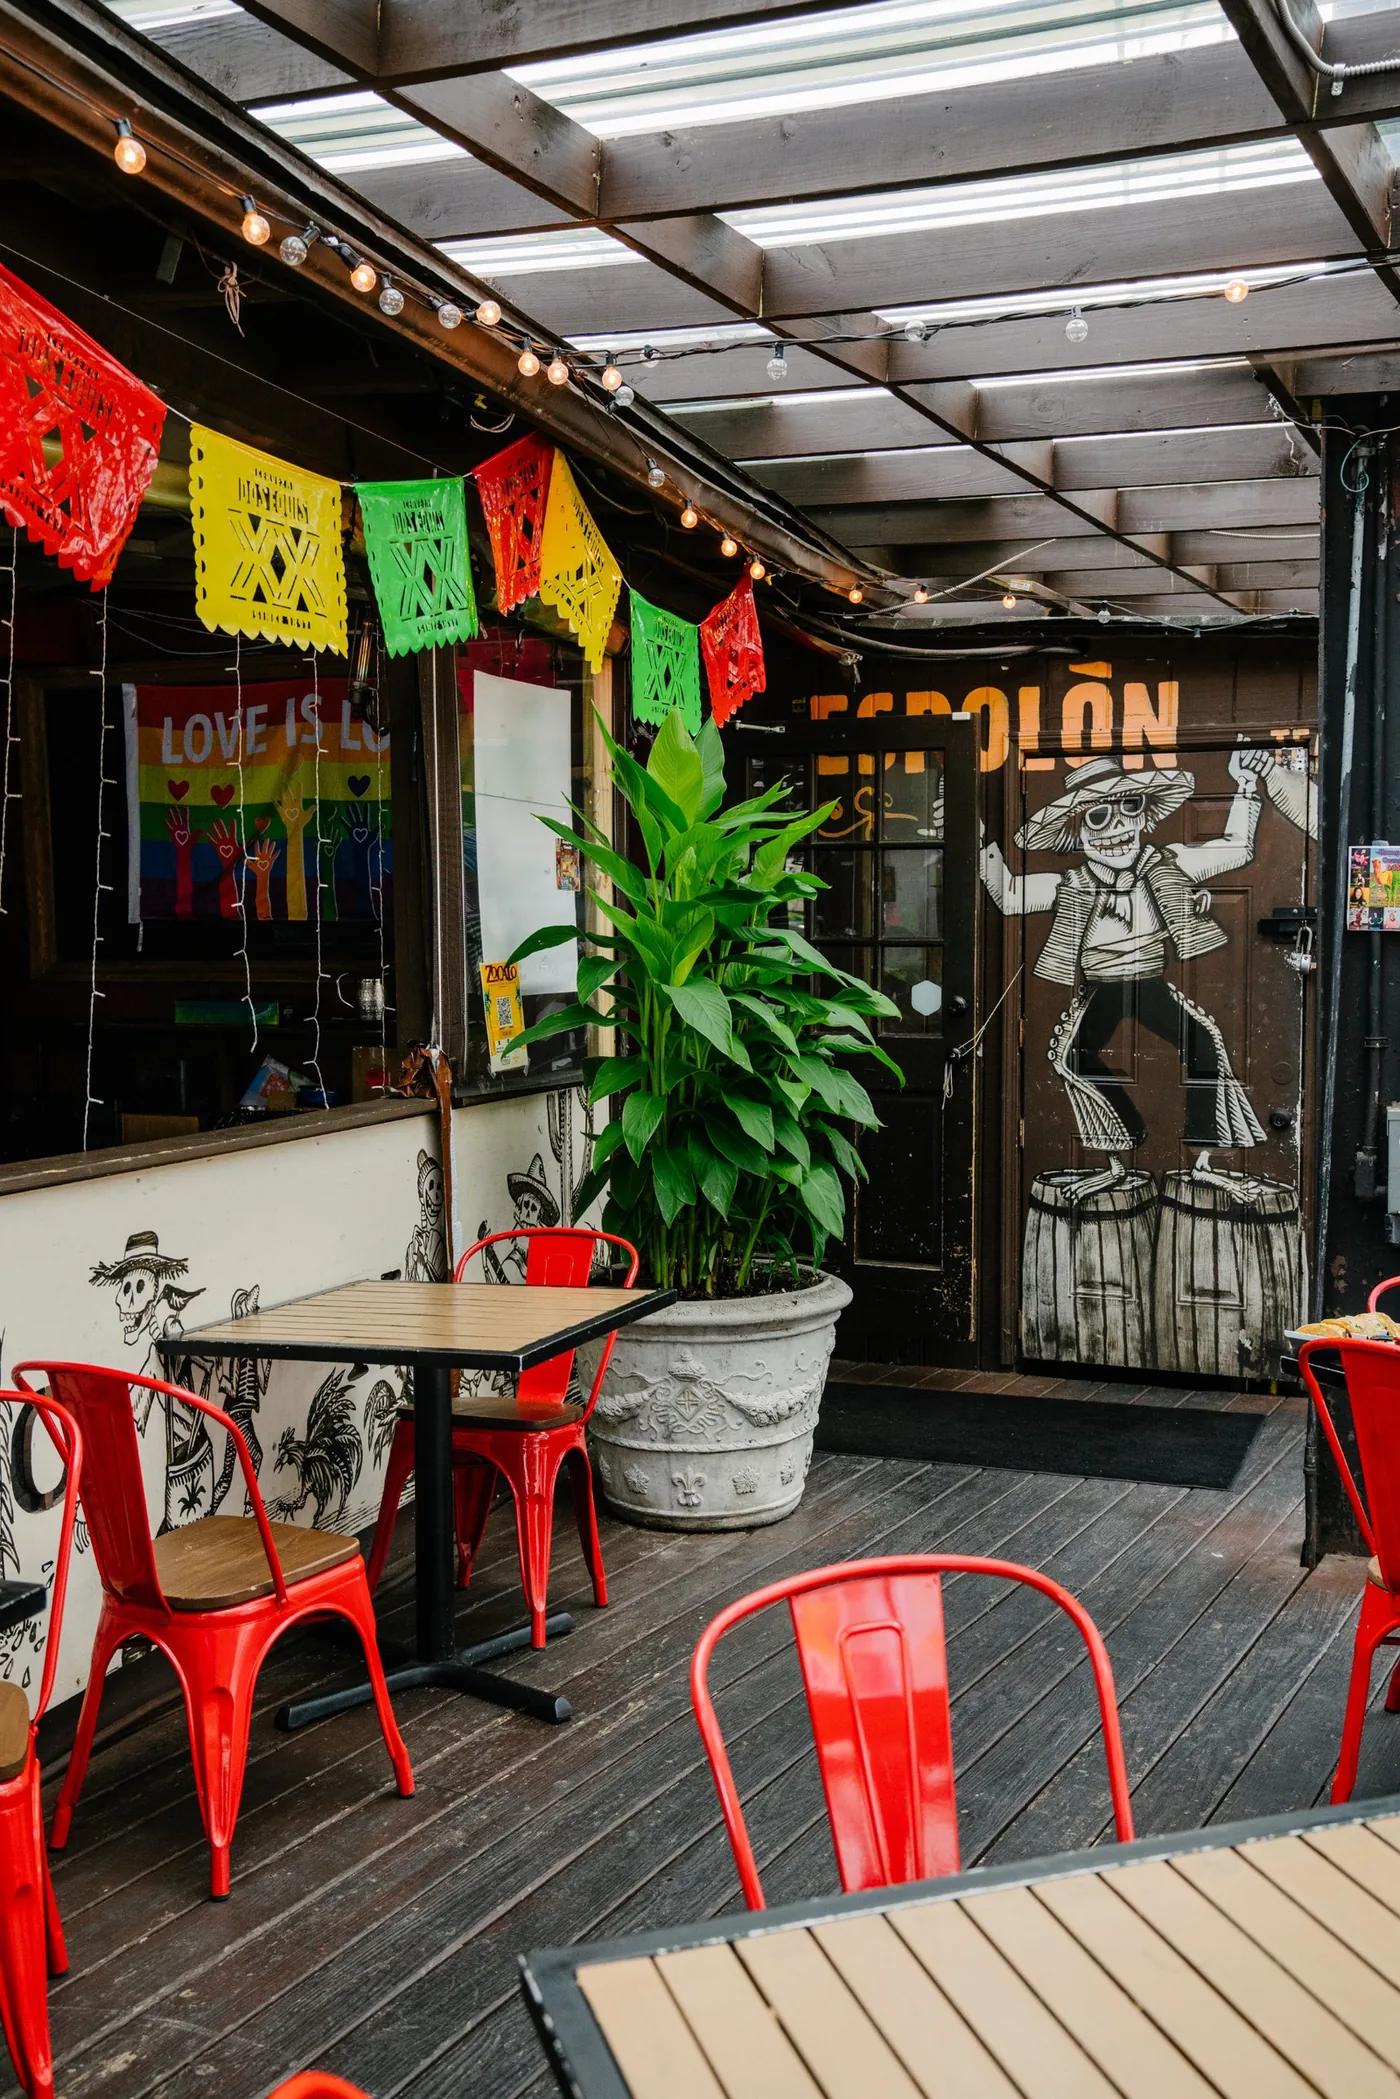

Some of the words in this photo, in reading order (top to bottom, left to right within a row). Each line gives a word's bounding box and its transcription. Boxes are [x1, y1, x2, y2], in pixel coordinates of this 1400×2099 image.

[228, 508, 327, 618] XX
[389, 536, 469, 622] XX
[162, 704, 268, 764] LOVE
[286, 693, 322, 747] IS
